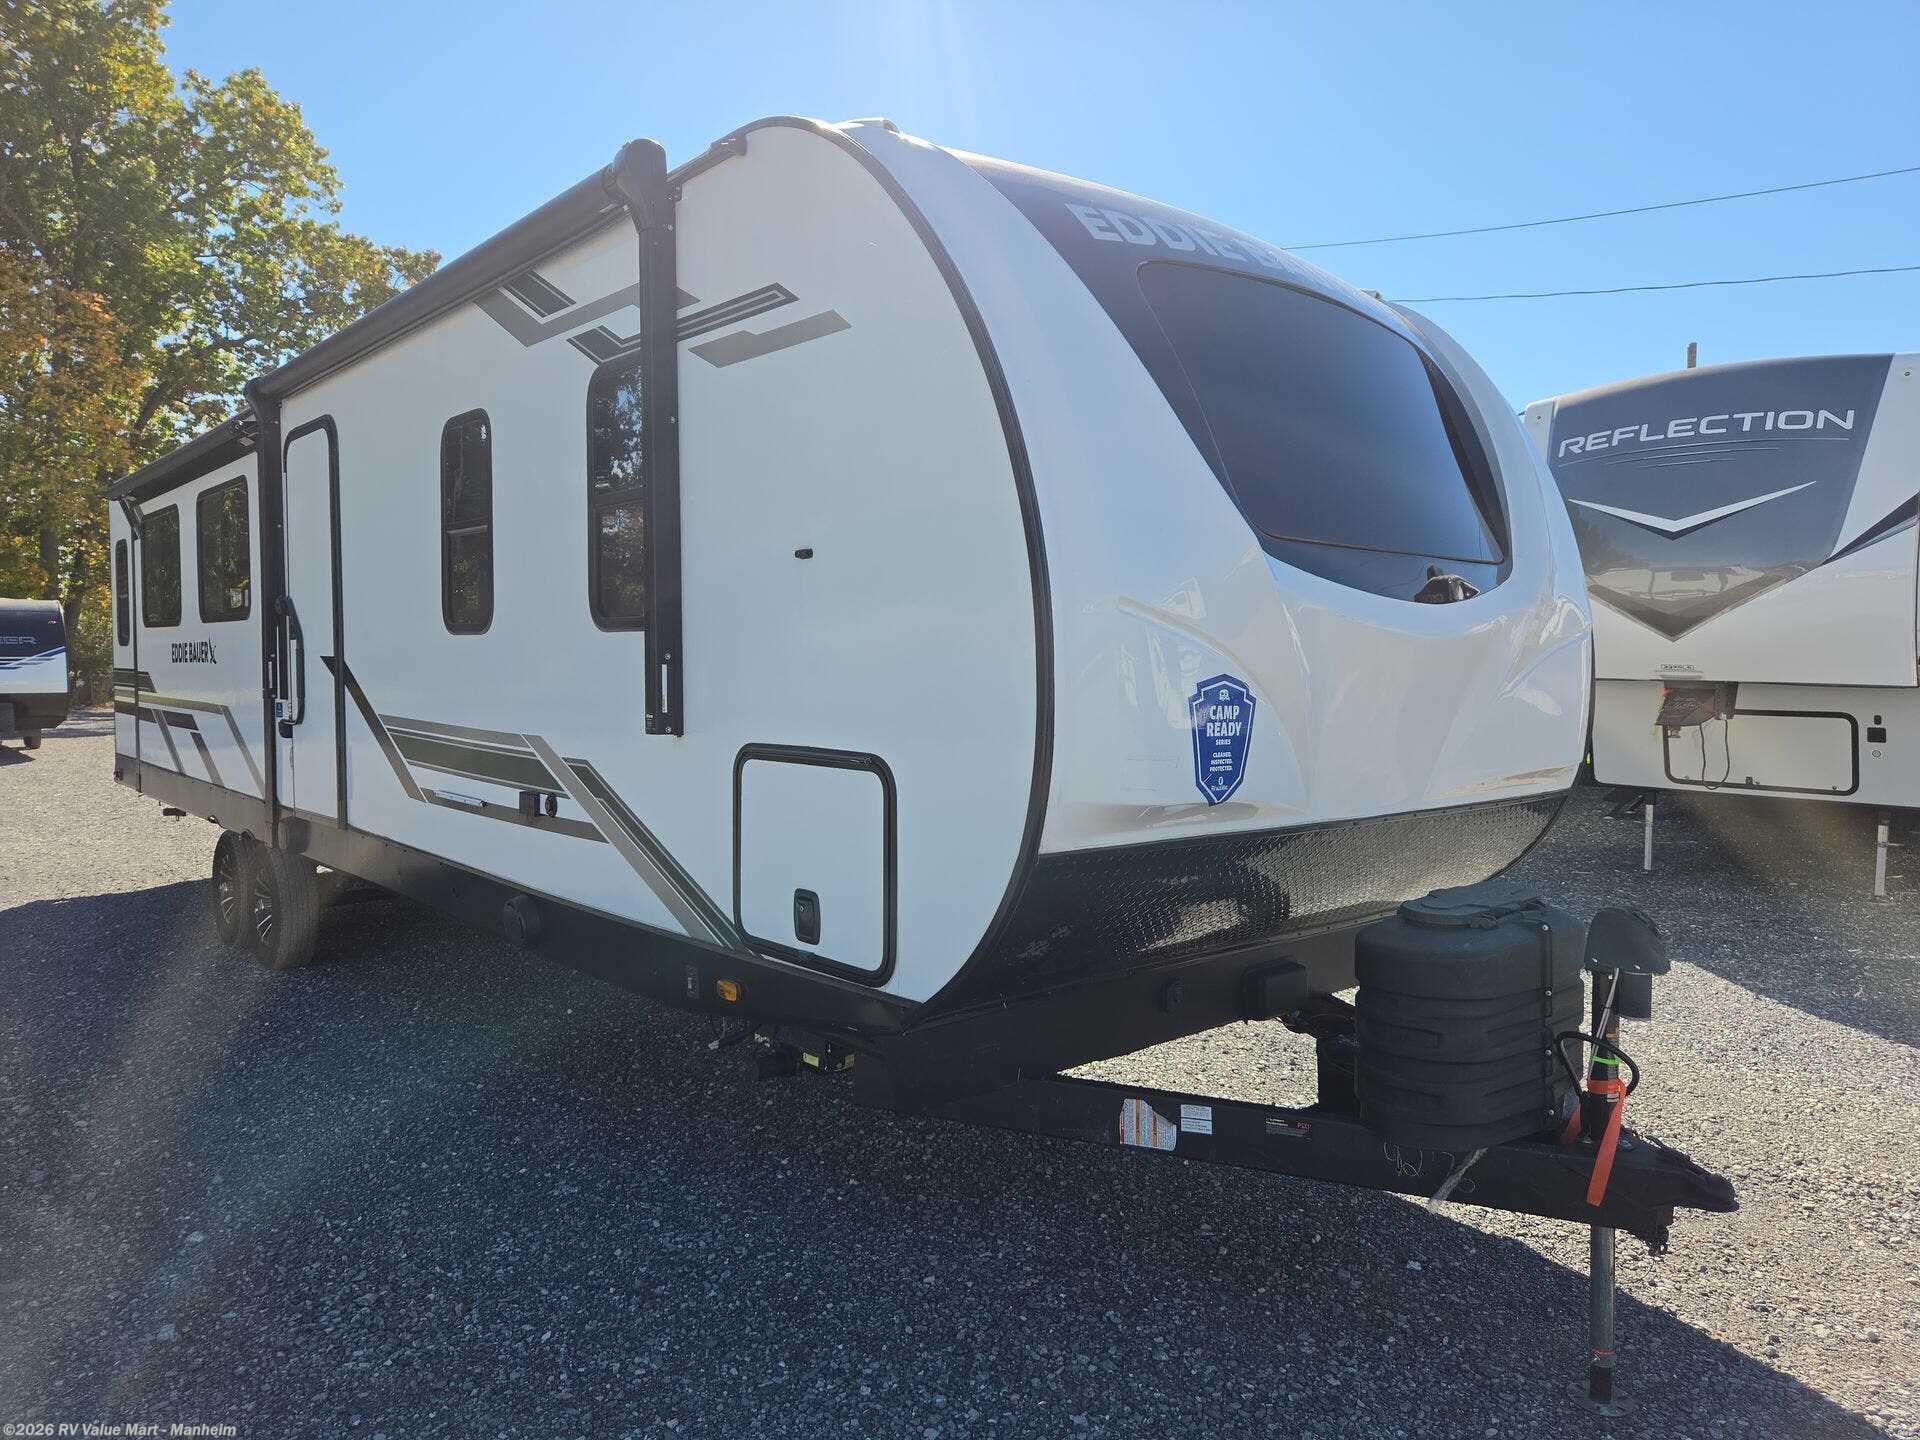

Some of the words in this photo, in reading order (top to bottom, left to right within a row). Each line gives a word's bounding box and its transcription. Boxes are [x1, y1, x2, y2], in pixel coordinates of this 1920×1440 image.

[1064, 203, 1248, 262] EDDIE
[1558, 409, 1855, 458] REFLECTION
[172, 643, 188, 663] EDDIE
[189, 641, 209, 663] BAUER
[1209, 705, 1240, 720] CAMP
[1206, 721, 1242, 737] READY
[1215, 738, 1231, 746] SERIES
